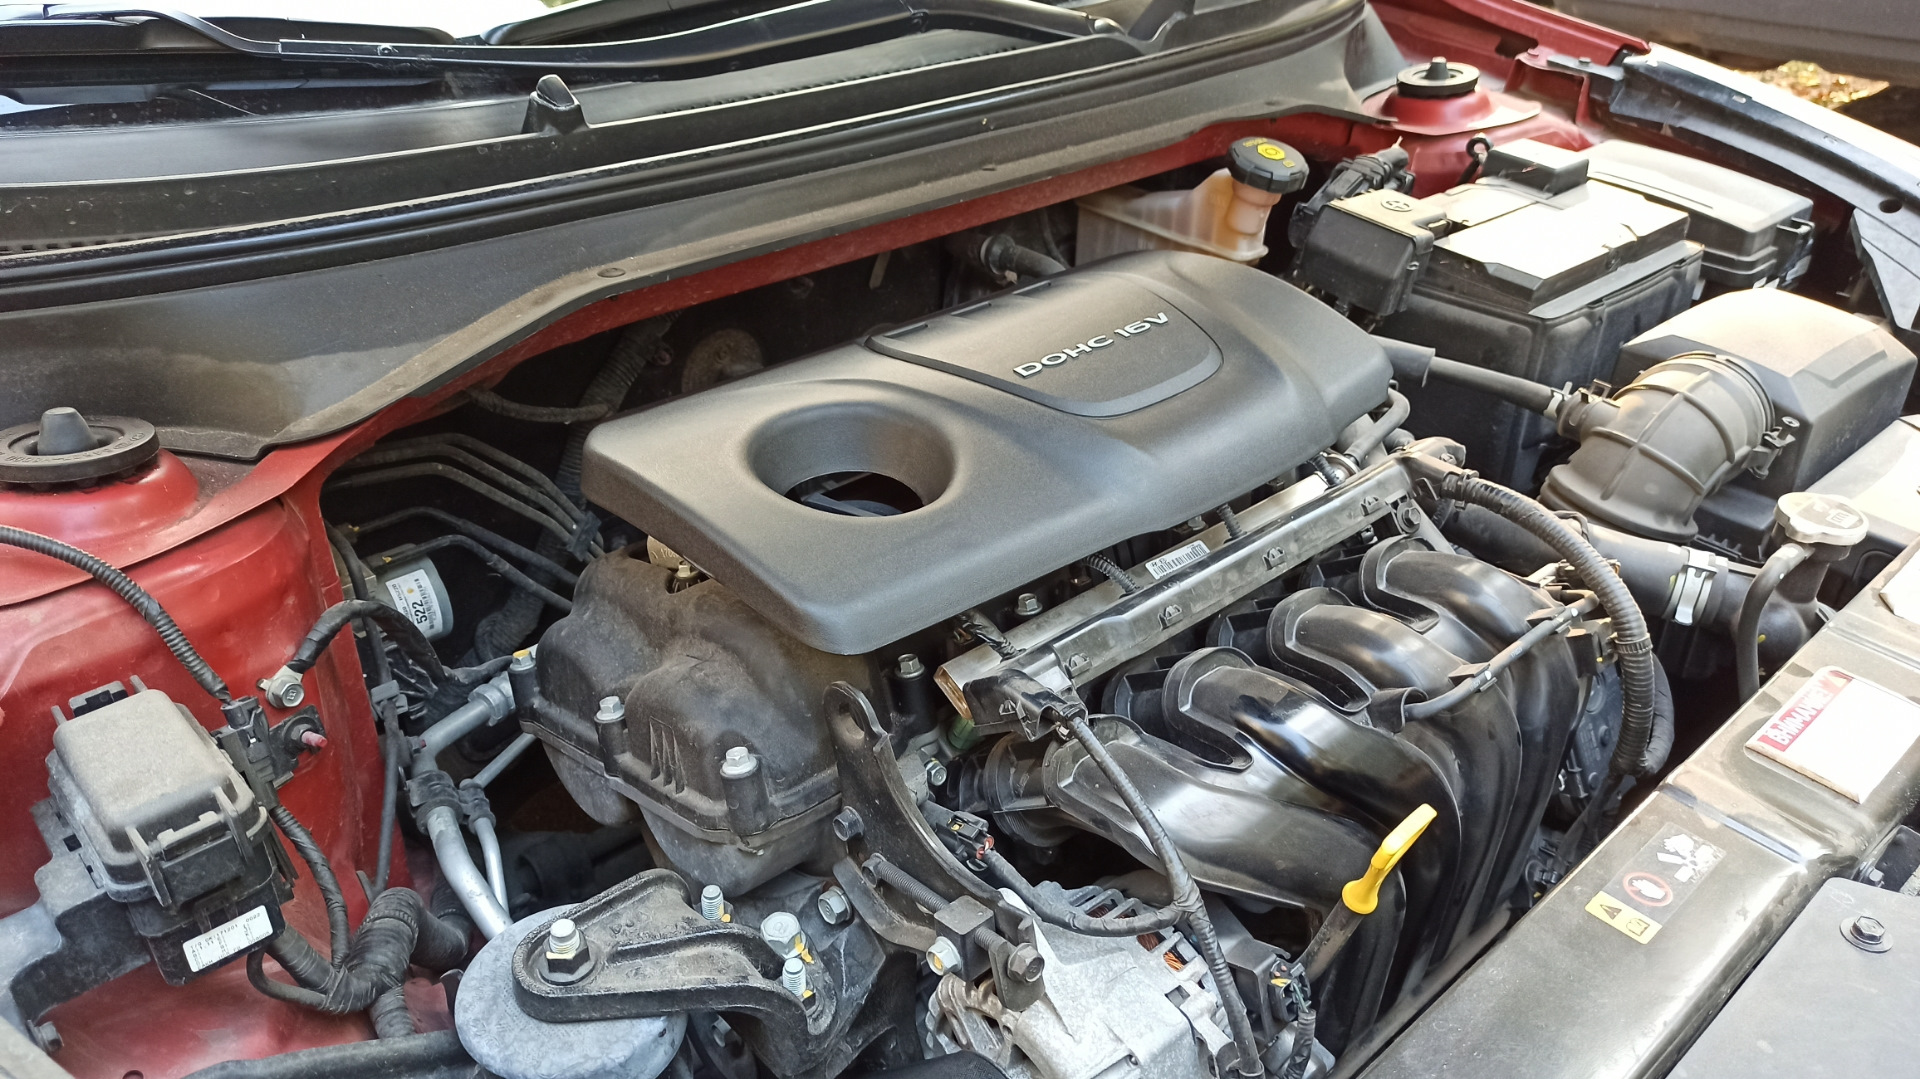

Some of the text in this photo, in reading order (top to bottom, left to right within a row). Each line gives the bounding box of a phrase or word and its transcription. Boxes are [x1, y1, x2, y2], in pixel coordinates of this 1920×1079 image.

[1013, 312, 1168, 378] DOHC 16V
[411, 600, 428, 624] 522
